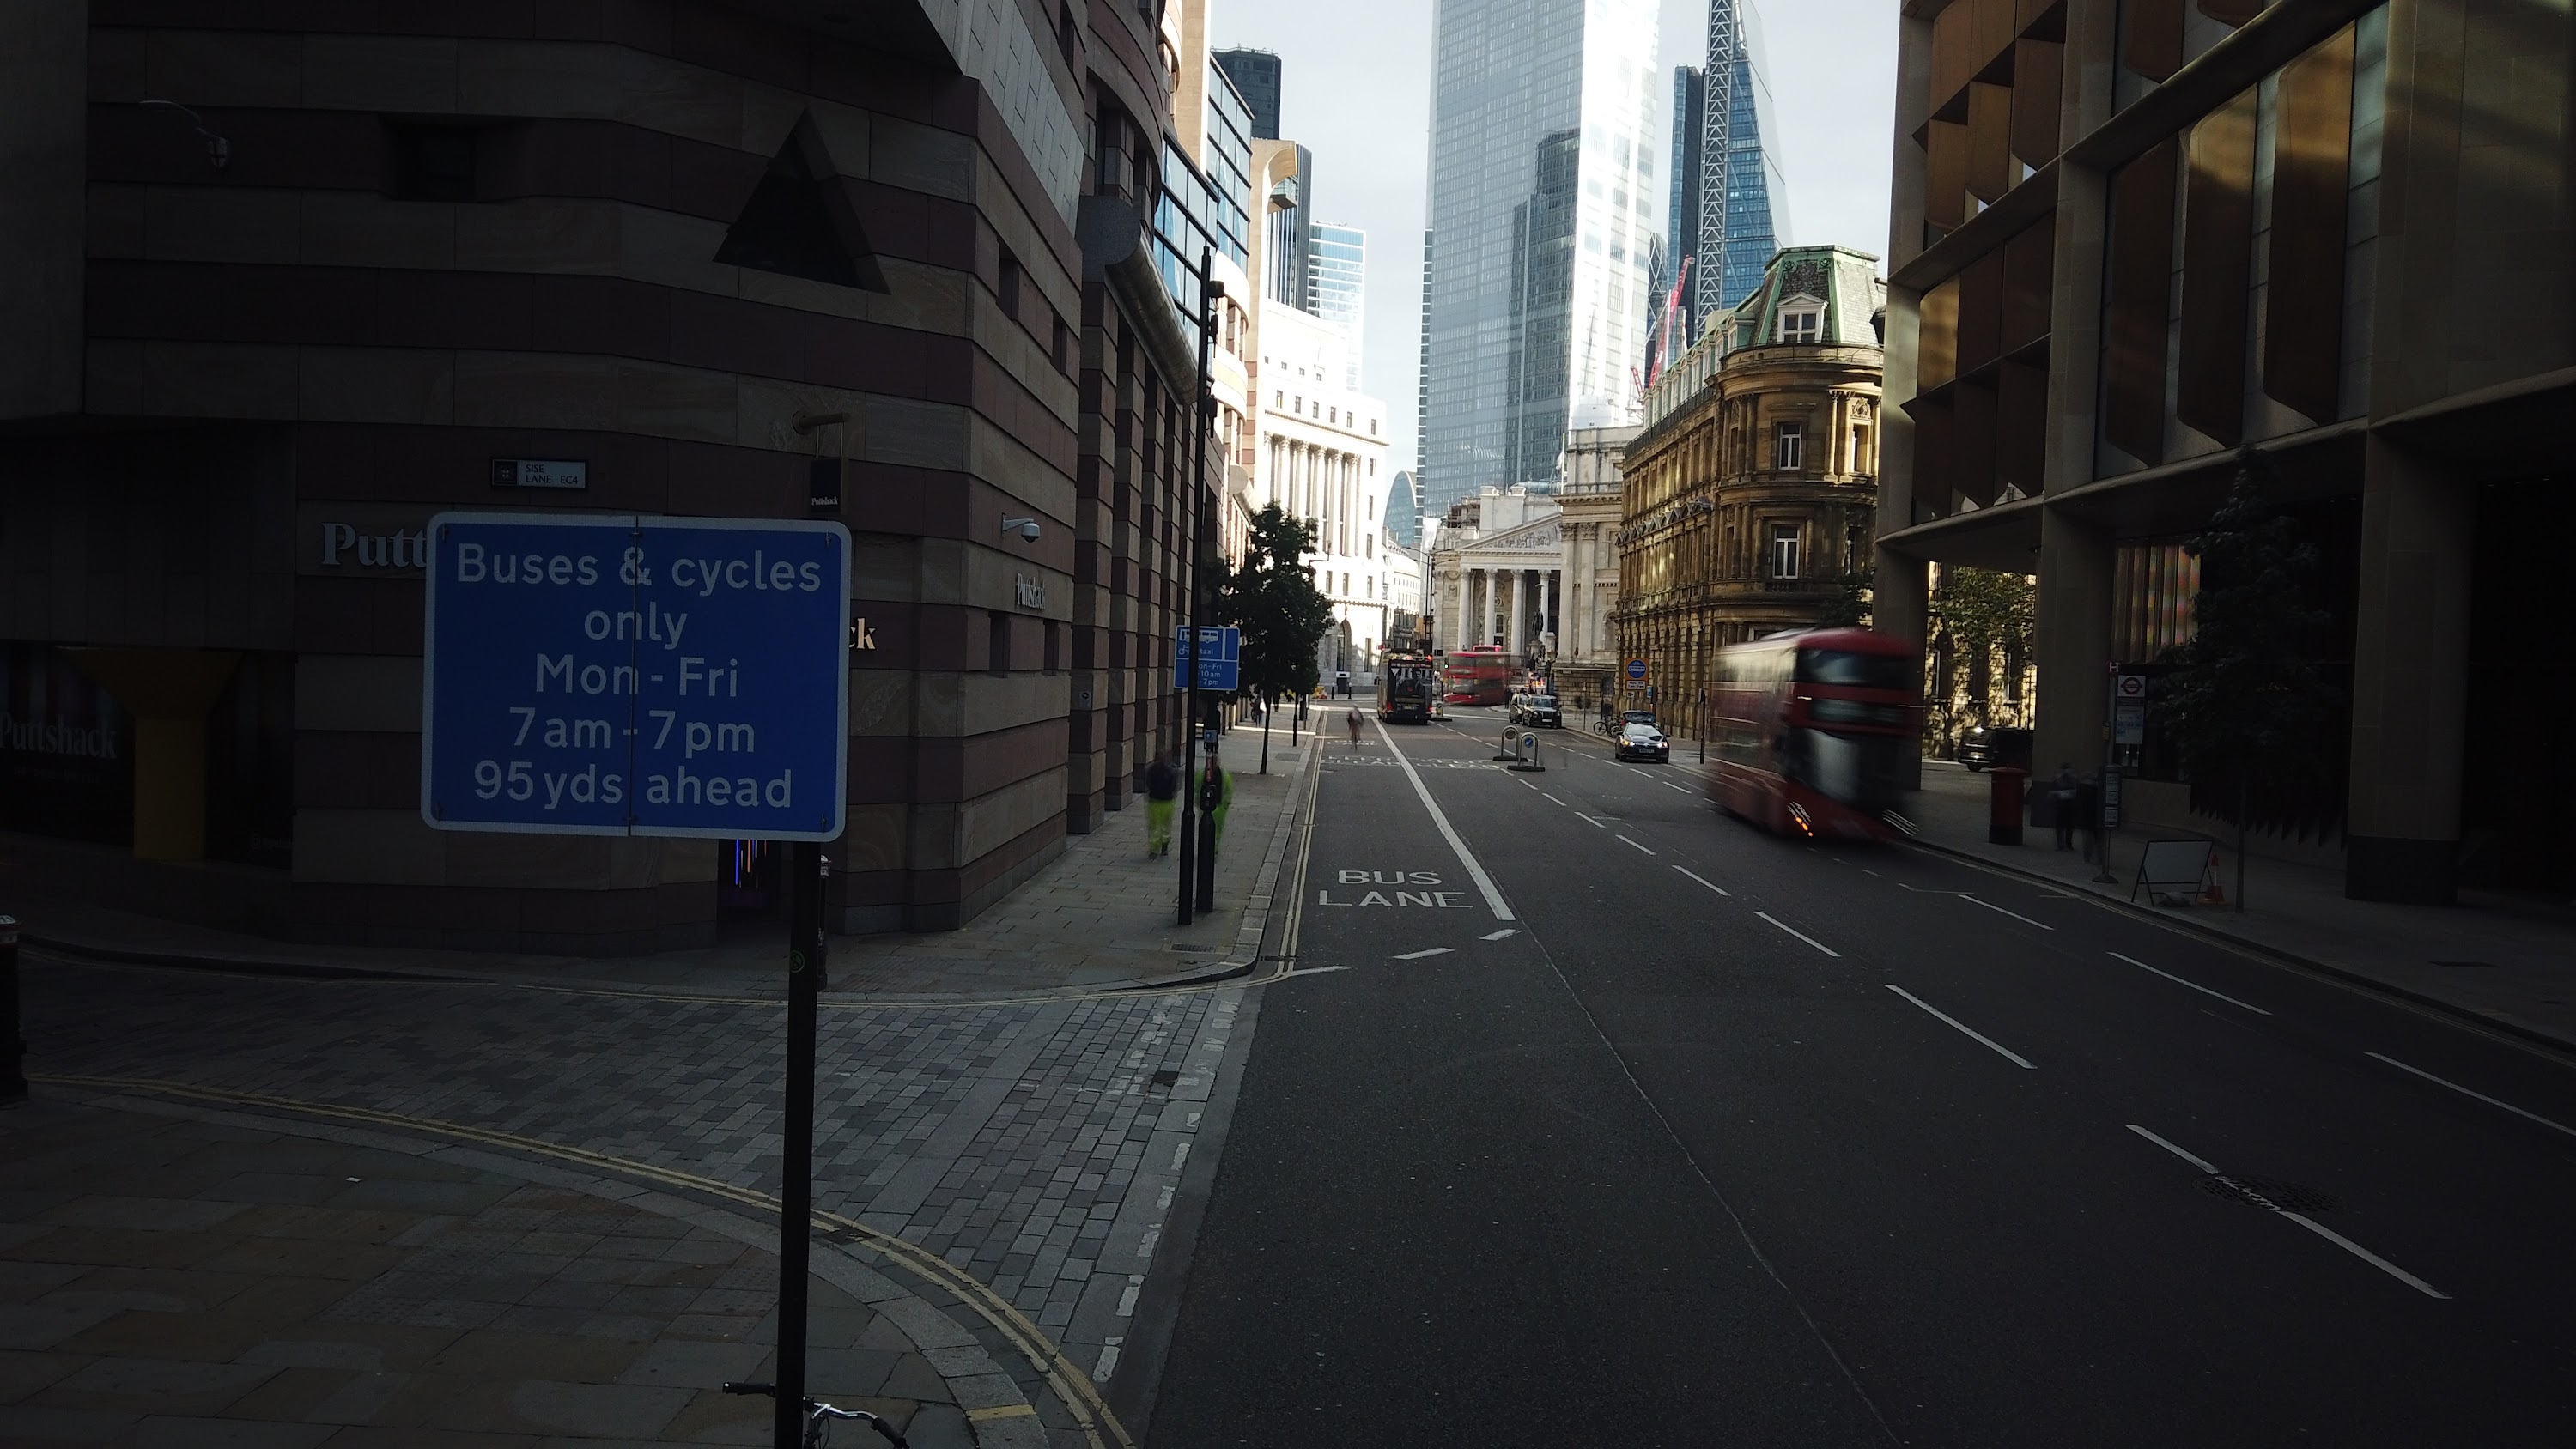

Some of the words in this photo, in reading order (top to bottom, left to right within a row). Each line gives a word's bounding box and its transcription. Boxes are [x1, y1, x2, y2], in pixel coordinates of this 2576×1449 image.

[526, 475, 551, 483] LANE
[560, 476, 578, 484] EC4
[457, 543, 598, 585] Buses
[618, 545, 653, 586] &
[671, 550, 822, 597] cycles
[584, 601, 689, 650] only
[645, 764, 793, 809] ahead
[1338, 870, 1443, 885] BUS
[1318, 889, 1474, 908] LANE
